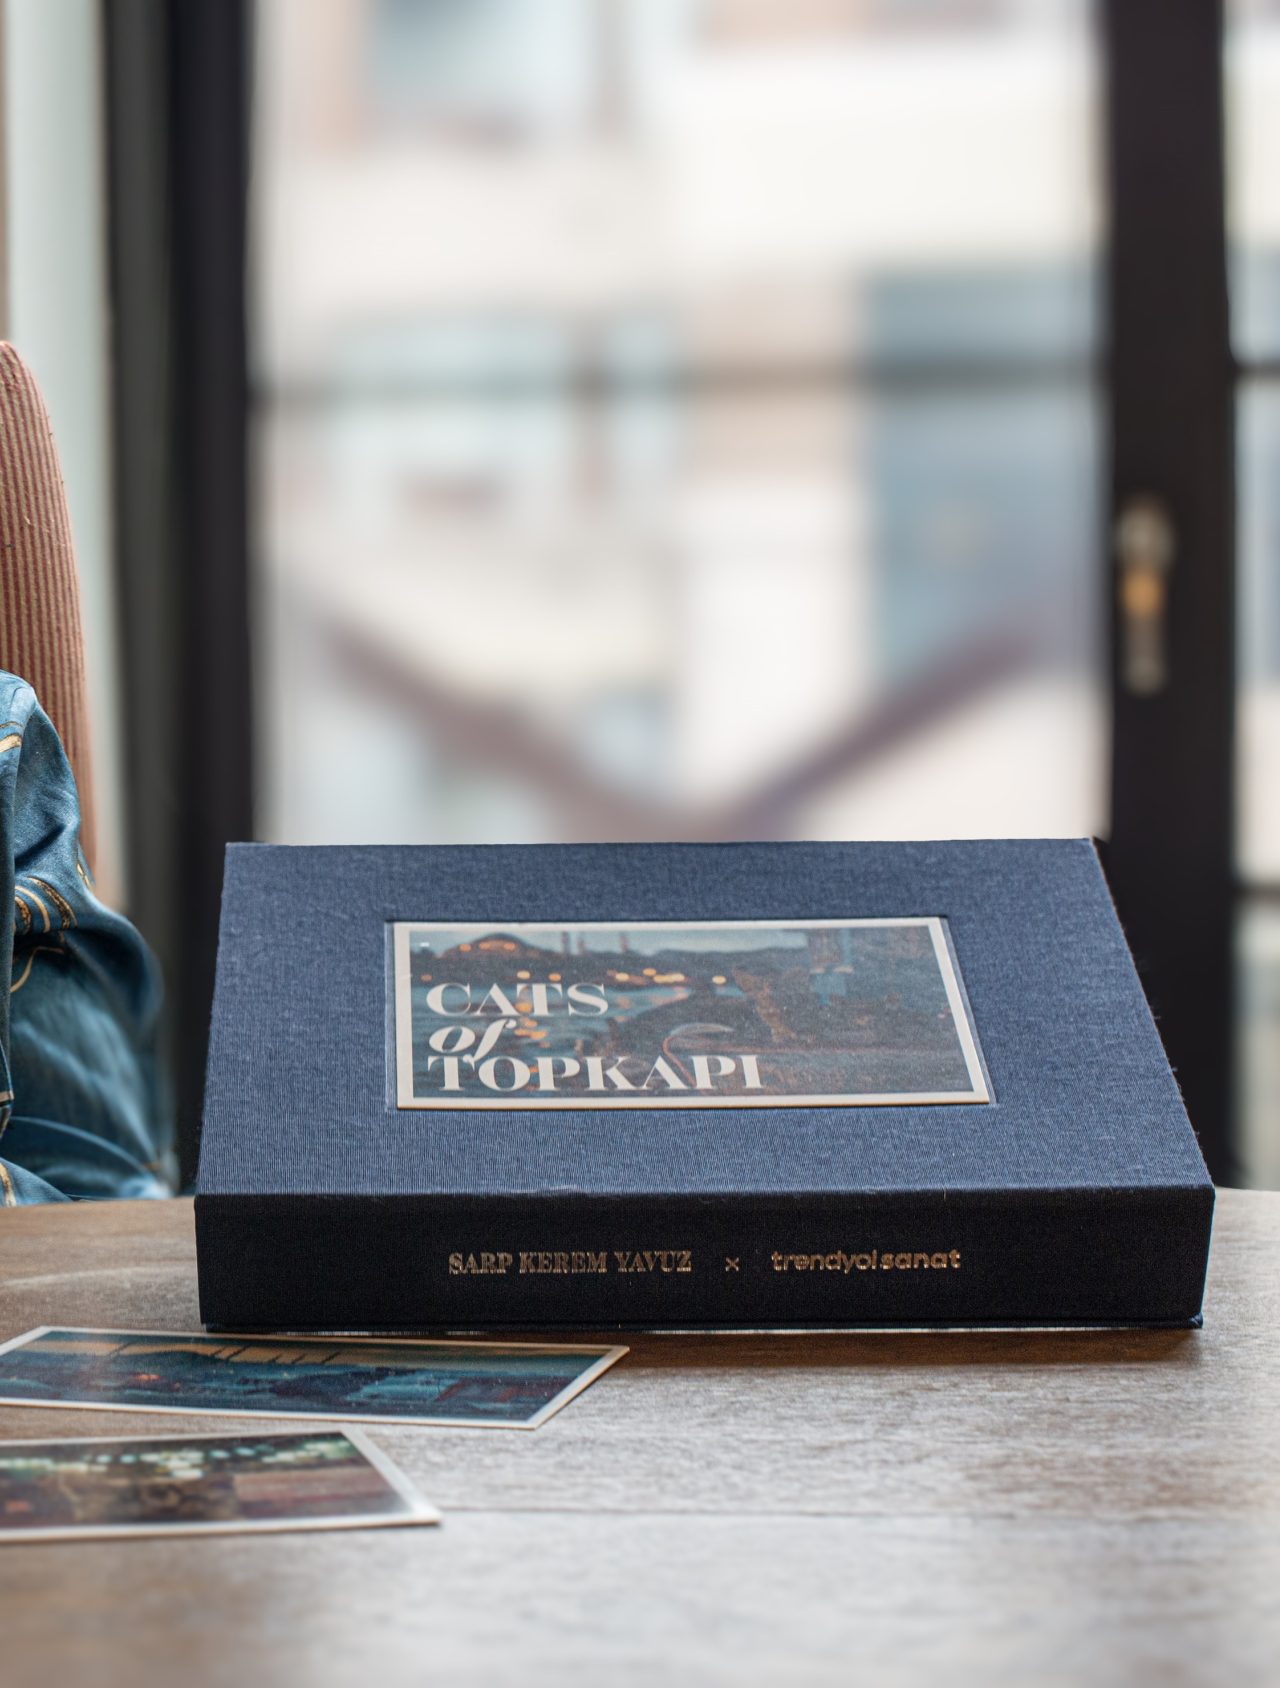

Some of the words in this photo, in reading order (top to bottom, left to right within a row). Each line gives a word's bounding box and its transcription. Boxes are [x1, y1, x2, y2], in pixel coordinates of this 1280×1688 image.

[426, 982, 609, 1017] CATS
[428, 1018, 517, 1062] of
[427, 1054, 763, 1092] TOPKAPI
[448, 1251, 513, 1275] SARP
[519, 1251, 608, 1274] KEREM
[614, 1250, 692, 1273] YAVUZ
